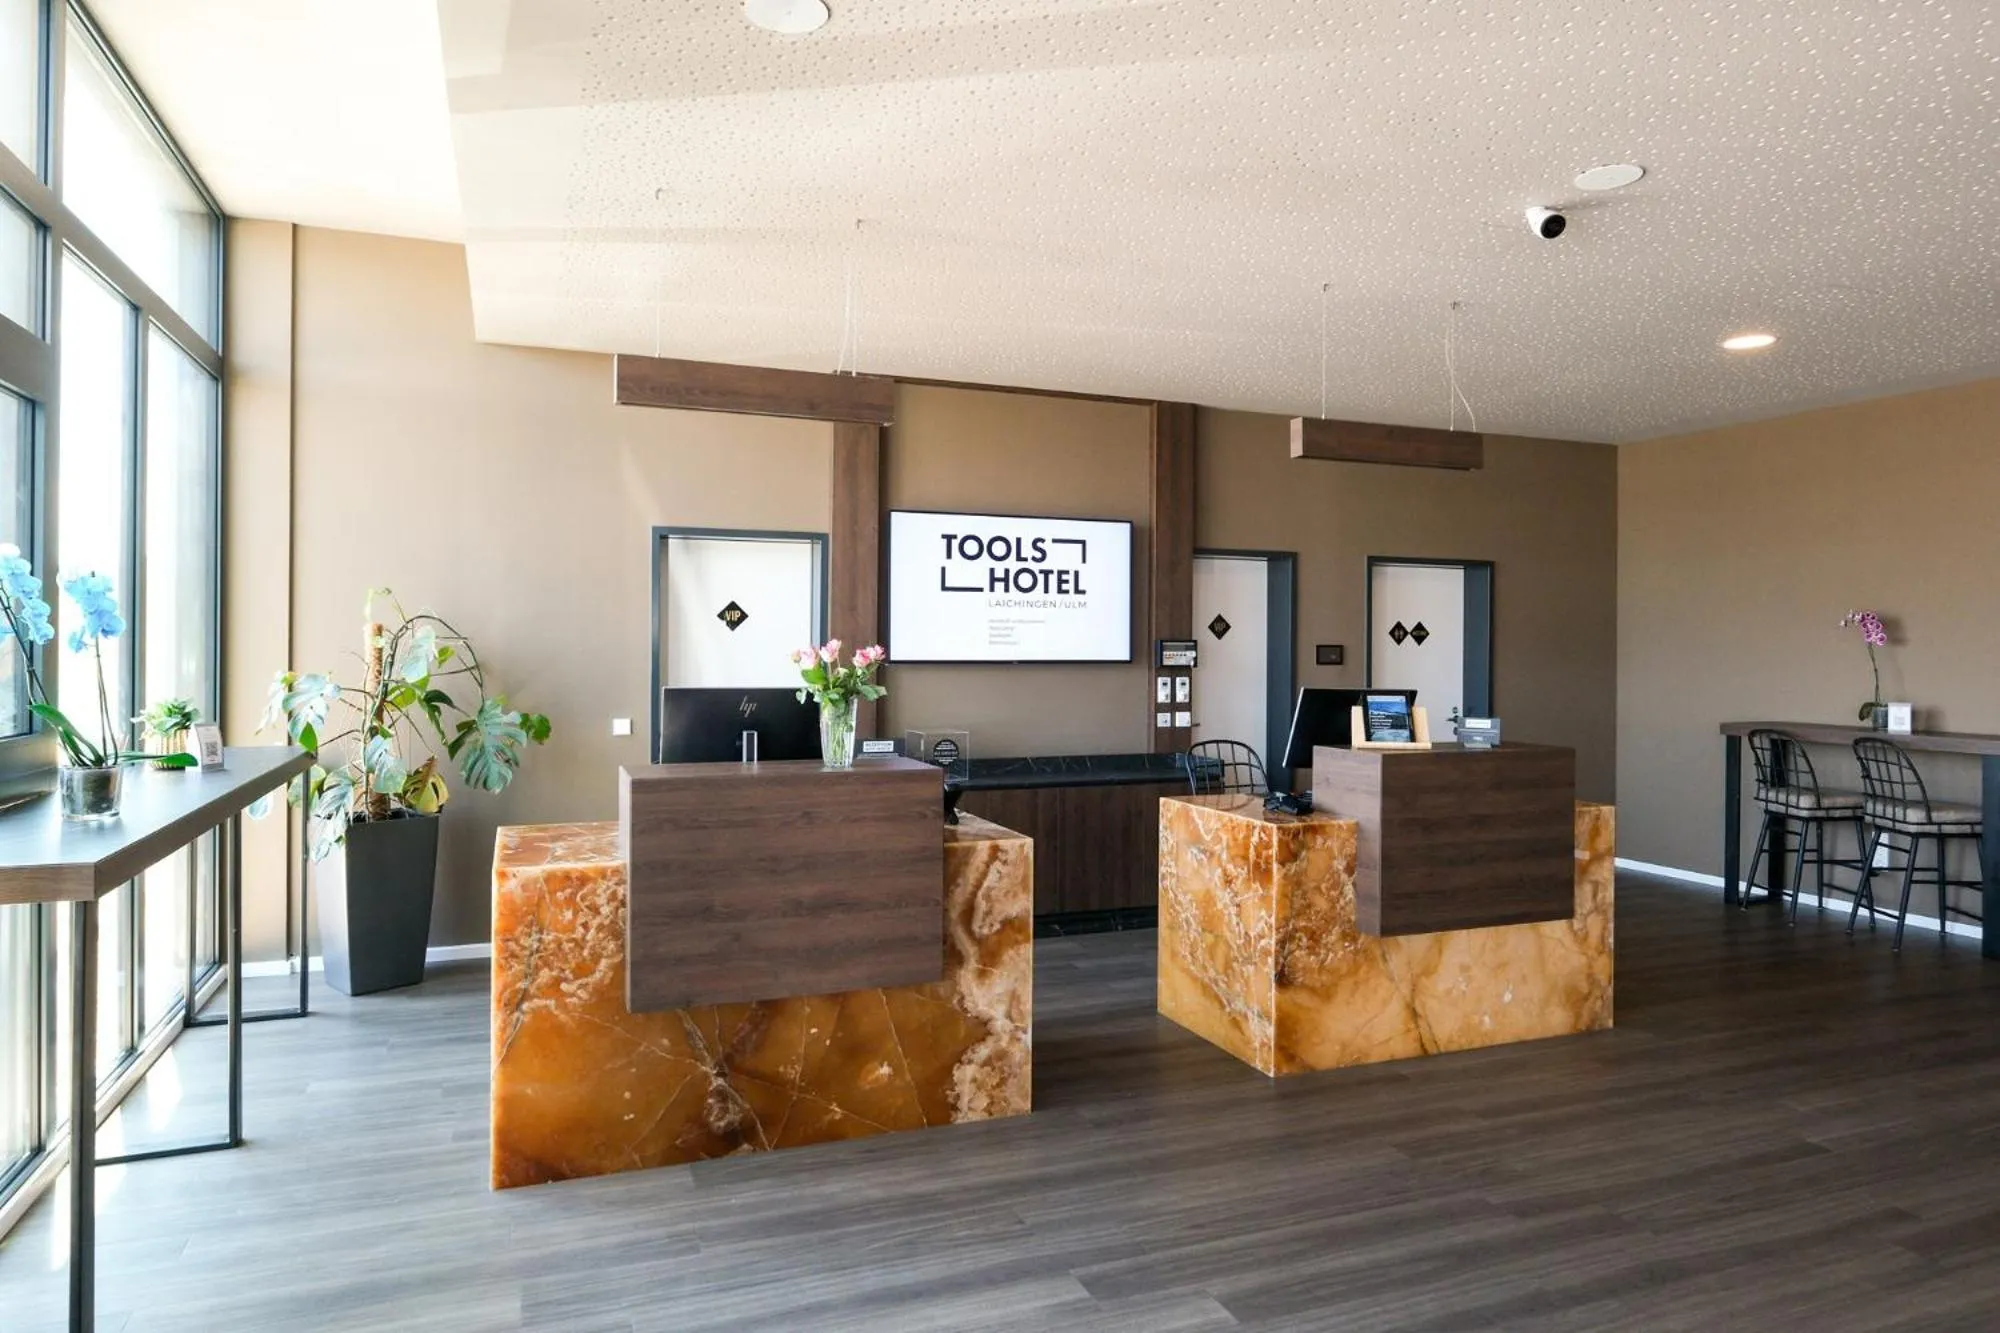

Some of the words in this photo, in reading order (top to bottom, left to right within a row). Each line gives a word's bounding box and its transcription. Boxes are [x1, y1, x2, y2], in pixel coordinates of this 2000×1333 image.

[941, 534, 1047, 563] TOOLS
[989, 567, 1087, 595] HOTEL
[725, 610, 741, 622] VIP
